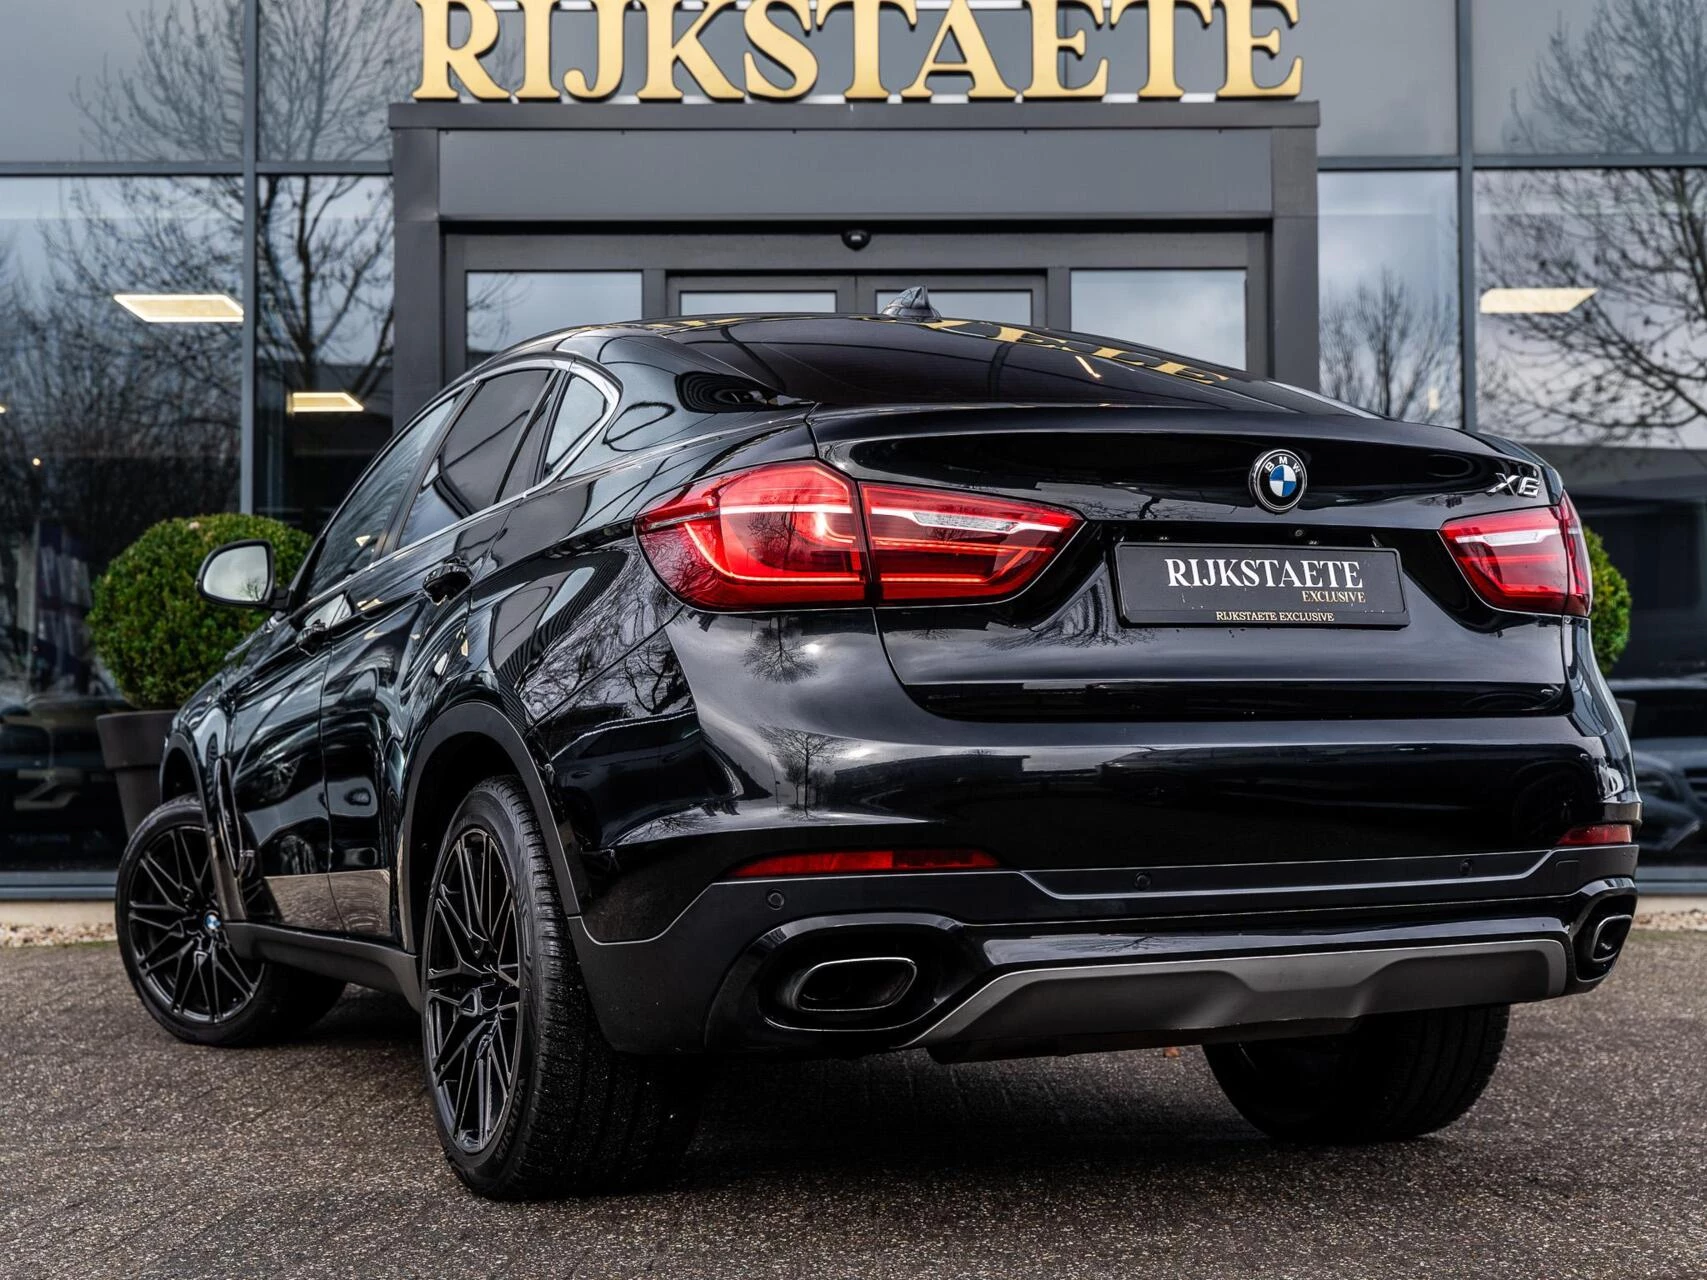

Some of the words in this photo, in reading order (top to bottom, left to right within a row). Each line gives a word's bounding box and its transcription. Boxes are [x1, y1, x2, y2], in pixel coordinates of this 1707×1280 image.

[412, 0, 1303, 101] RIJKSTAETE
[1265, 456, 1301, 473] BMW
[1486, 473, 1540, 498] X6
[1164, 558, 1363, 588] RIJKSTAETE
[1301, 590, 1366, 604] EXCLUSIVE
[1216, 611, 1278, 622] RIJKSTAETE
[1279, 611, 1335, 622] EXCLUSIVE
